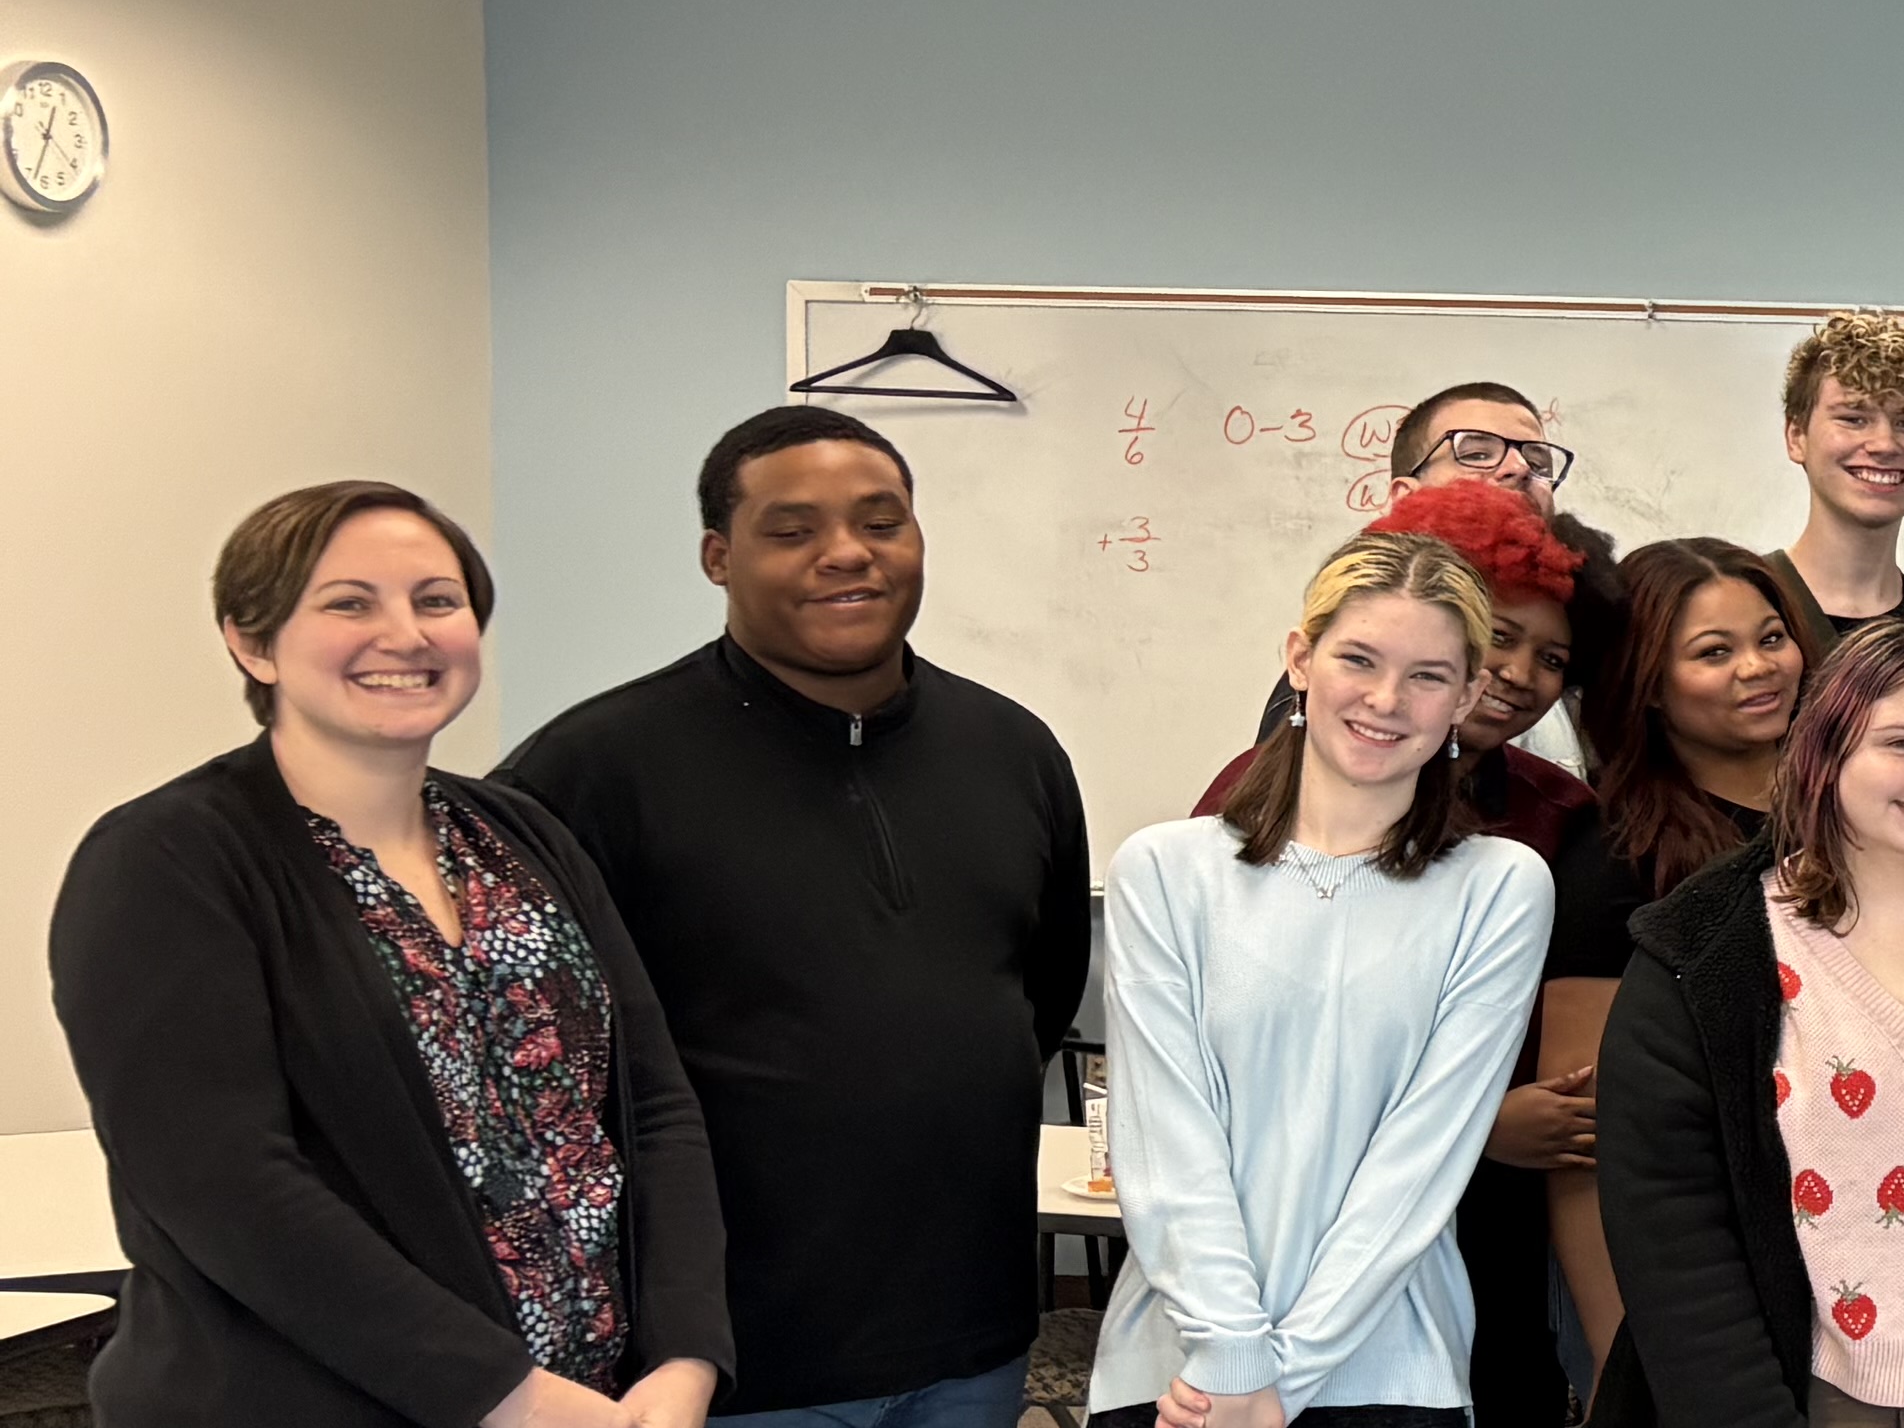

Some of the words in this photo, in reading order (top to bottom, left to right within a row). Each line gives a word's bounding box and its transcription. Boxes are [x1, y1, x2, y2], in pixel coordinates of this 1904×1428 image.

[1122, 396, 1149, 430] 4
[1123, 434, 1145, 465] 6
[1126, 549, 1150, 572] 3
